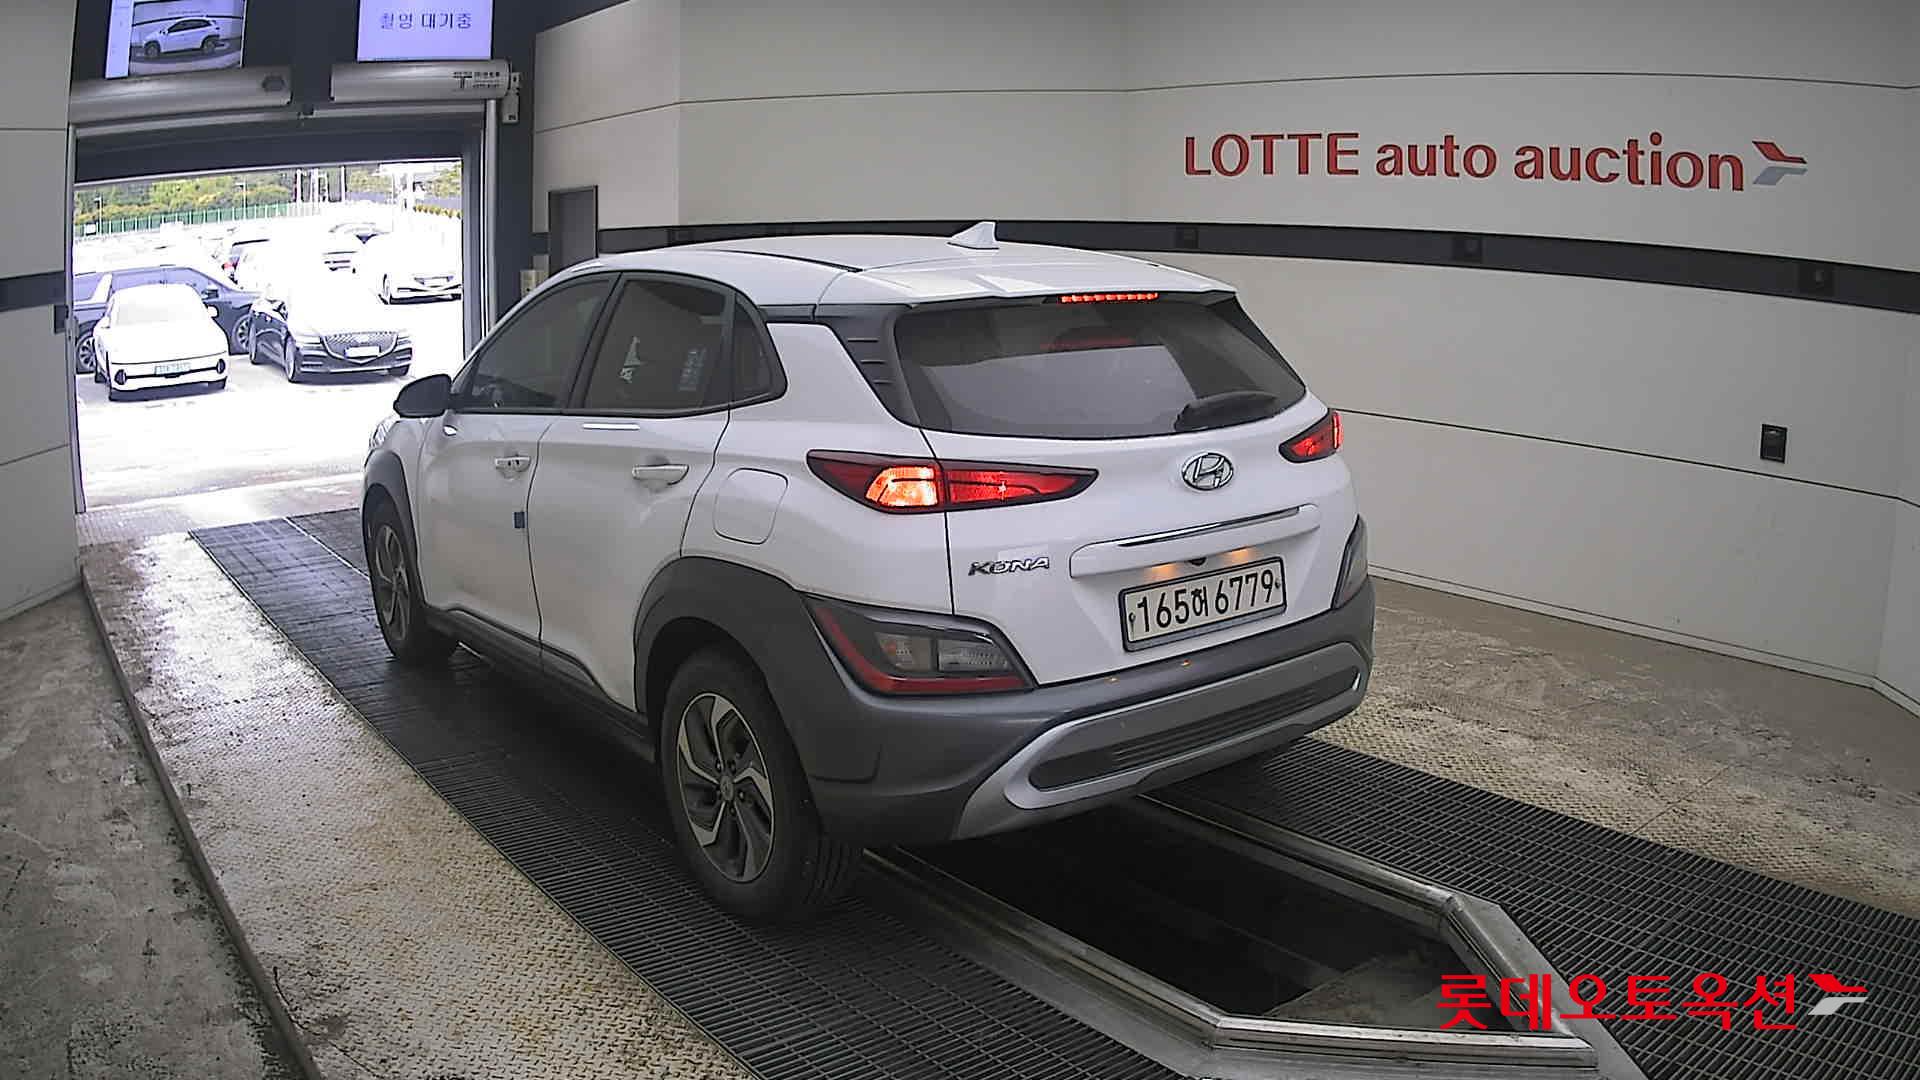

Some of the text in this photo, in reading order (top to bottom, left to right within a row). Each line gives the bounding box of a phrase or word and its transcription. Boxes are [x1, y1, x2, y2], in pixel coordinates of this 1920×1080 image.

[421, 12, 472, 29] 대기중
[1185, 132, 1745, 191] LOTTE auto auction
[968, 557, 1051, 576] KONA
